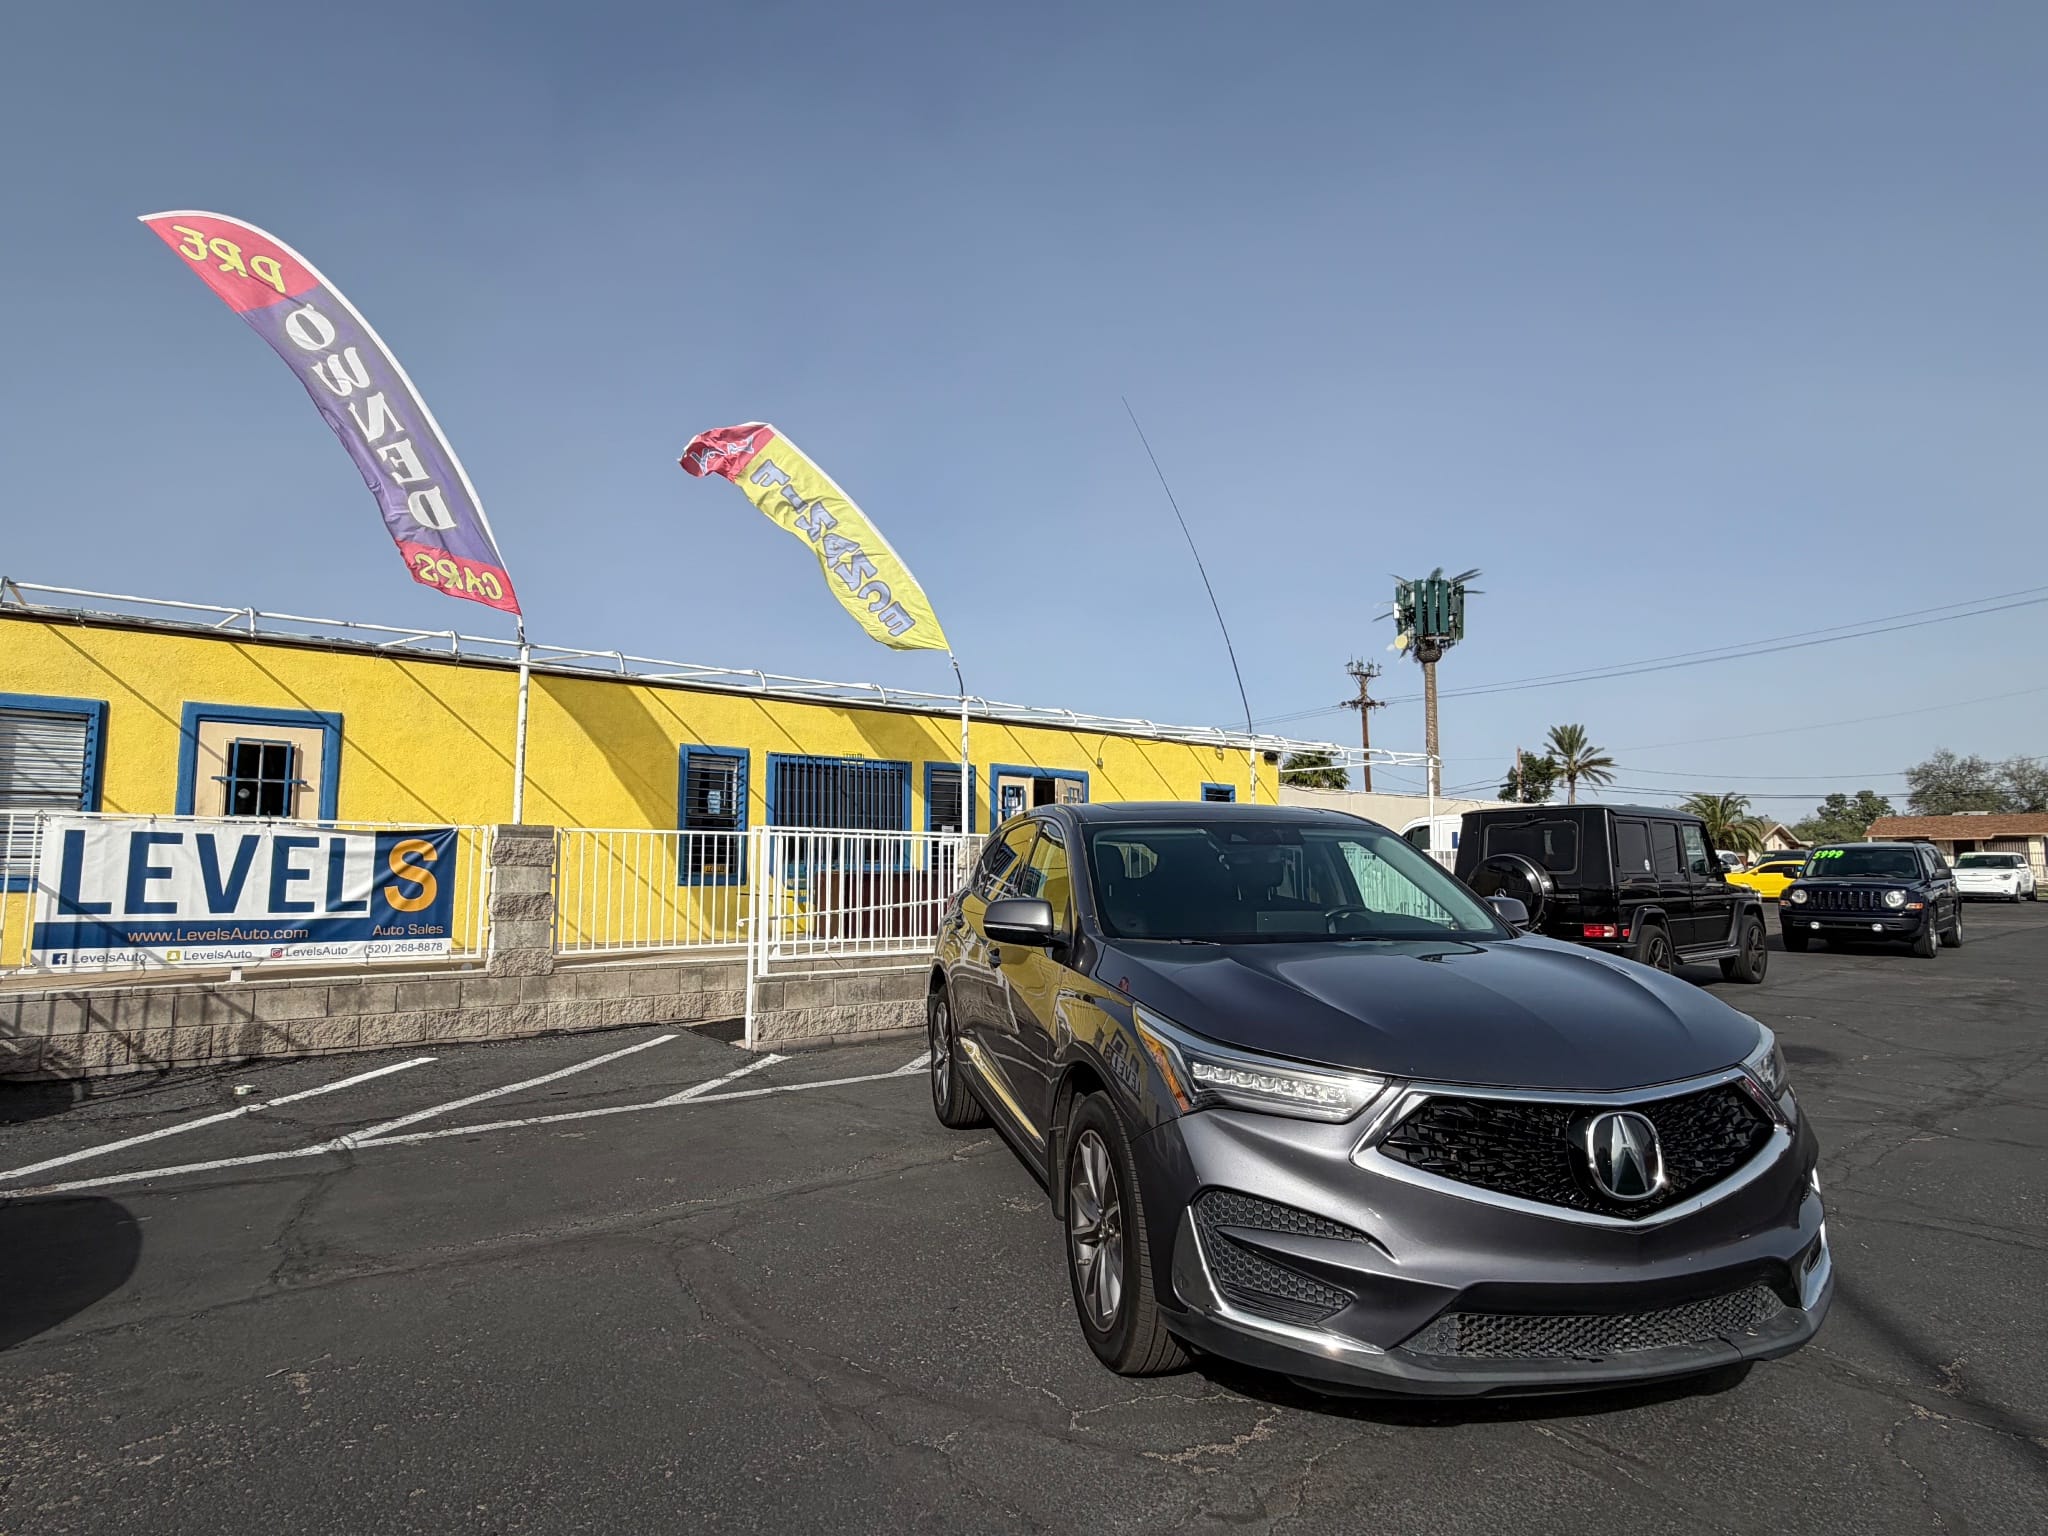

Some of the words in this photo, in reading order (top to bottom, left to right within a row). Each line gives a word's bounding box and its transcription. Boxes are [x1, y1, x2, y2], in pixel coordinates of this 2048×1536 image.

[1812, 850, 1845, 859] 5999
[57, 828, 438, 915] LEVELS
[128, 926, 309, 942] www.LevelsAuto.com
[372, 924, 404, 936] Auto
[408, 923, 444, 935] Sales
[184, 949, 252, 960] LevelsAuto
[286, 946, 348, 957] LevelsAuto
[363, 943, 391, 955] (520)
[394, 942, 443, 953] 268-8878
[72, 951, 147, 964] LevelsAuto
